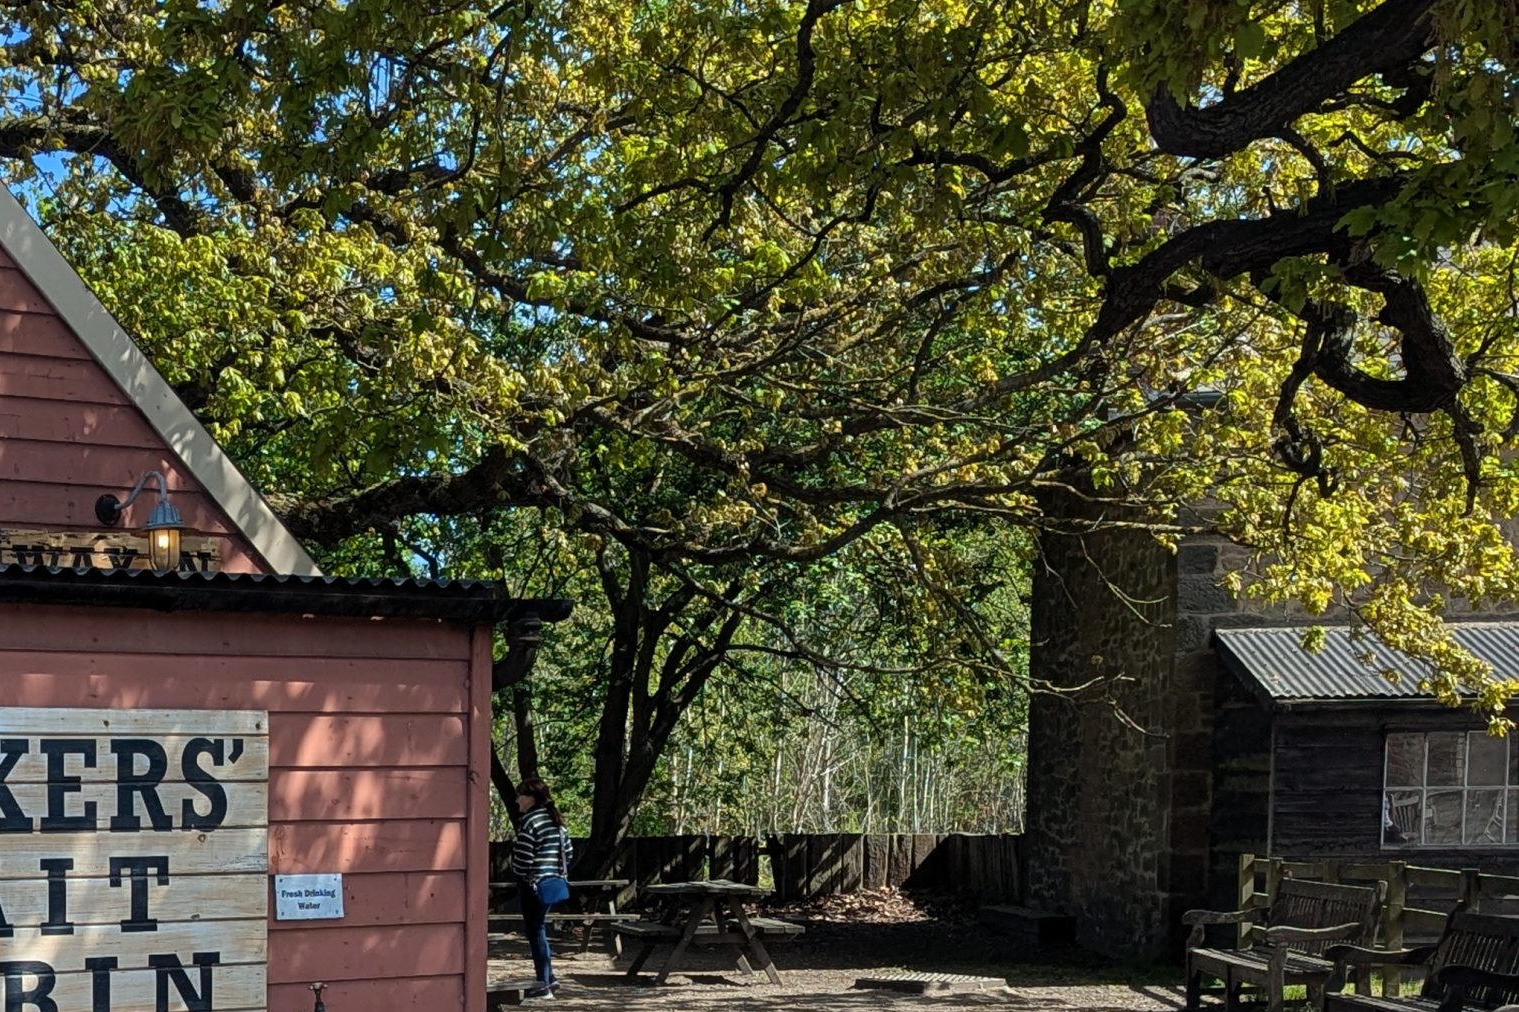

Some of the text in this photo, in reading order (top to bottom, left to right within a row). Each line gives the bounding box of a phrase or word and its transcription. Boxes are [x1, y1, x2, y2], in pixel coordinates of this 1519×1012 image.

[281, 888, 336, 898] Fresh Drinking
[298, 902, 321, 911] Water
